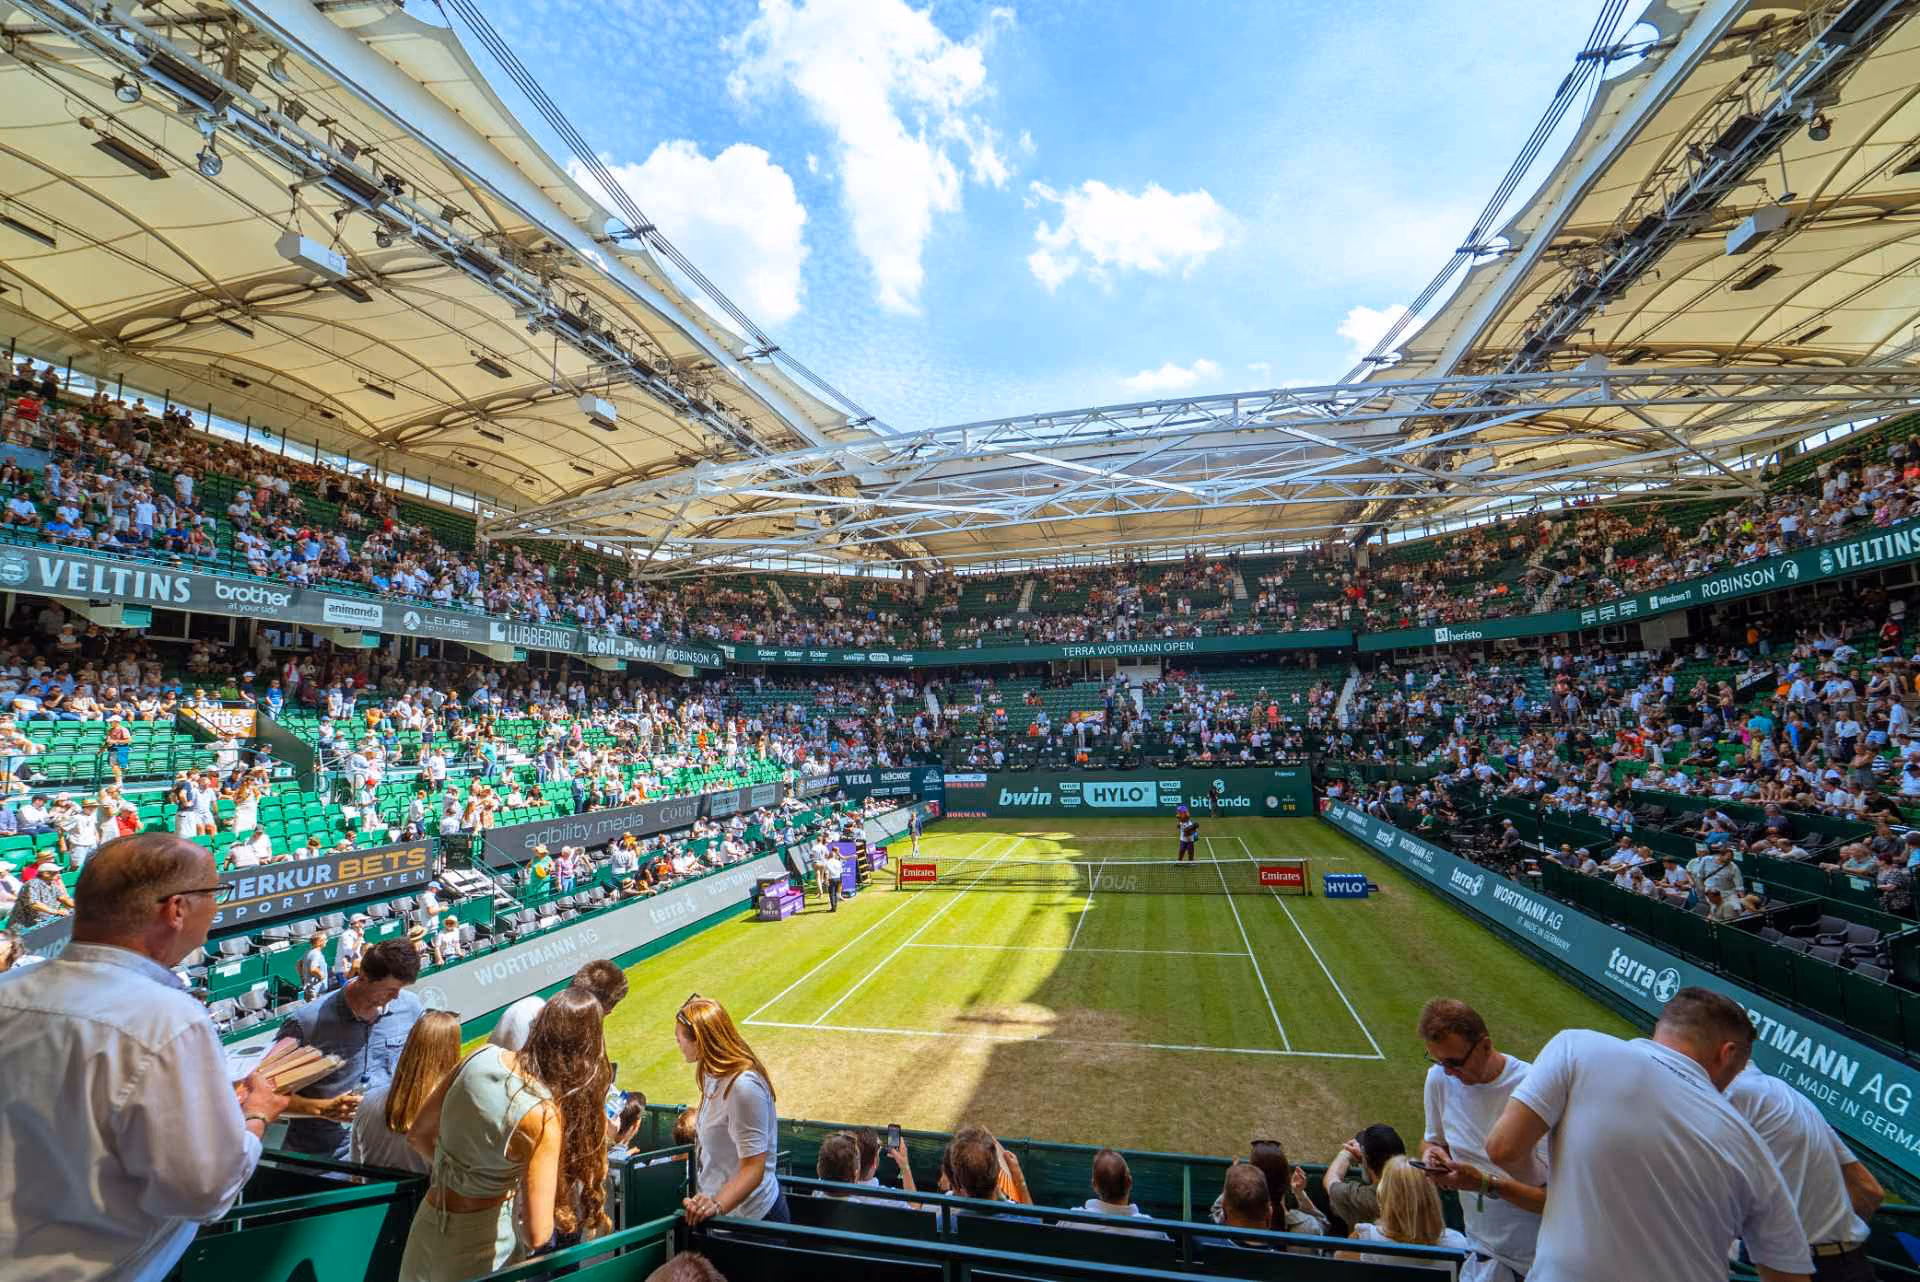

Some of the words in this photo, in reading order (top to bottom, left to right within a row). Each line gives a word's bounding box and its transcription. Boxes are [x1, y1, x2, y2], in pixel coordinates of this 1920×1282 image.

[1834, 527, 1920, 568] VELTINS
[37, 556, 192, 603] VELTINS
[1702, 567, 1776, 598] ROBINSON
[215, 581, 291, 607] brother
[1659, 593, 1685, 605] Windows
[239, 604, 261, 613] your
[328, 604, 379, 618] animonda
[1449, 629, 1482, 641] heristo
[666, 648, 710, 664] ROBINSON
[1063, 647, 1096, 657] TERRA
[1097, 643, 1161, 655] WORTMANN
[1164, 642, 1194, 652] OPEN
[845, 774, 872, 785] VEKA
[999, 786, 1052, 806] bwin
[659, 801, 701, 824] COURT
[524, 820, 592, 848] adbility
[595, 812, 644, 834] media
[1376, 828, 1390, 844] terra
[1399, 837, 1427, 859] WORTMANN
[1424, 850, 1434, 863] AG
[338, 847, 426, 880] BETS
[903, 868, 935, 877] Emirates
[1261, 872, 1301, 881] Emirates
[211, 869, 426, 924] SPORTWETTEN
[1451, 867, 1473, 889] terra
[1493, 884, 1548, 922] WORTMANN
[1545, 909, 1564, 930] AG
[649, 901, 685, 923] terra
[473, 937, 577, 987] WORTMANN
[577, 929, 600, 946] AG
[1608, 947, 1657, 989] terra
[1746, 1008, 1860, 1088] RTMANN
[1859, 1073, 1913, 1117] AG
[1777, 1062, 1794, 1081] IT.
[1796, 1072, 1841, 1106] MADE
[1840, 1097, 1860, 1118] IN
